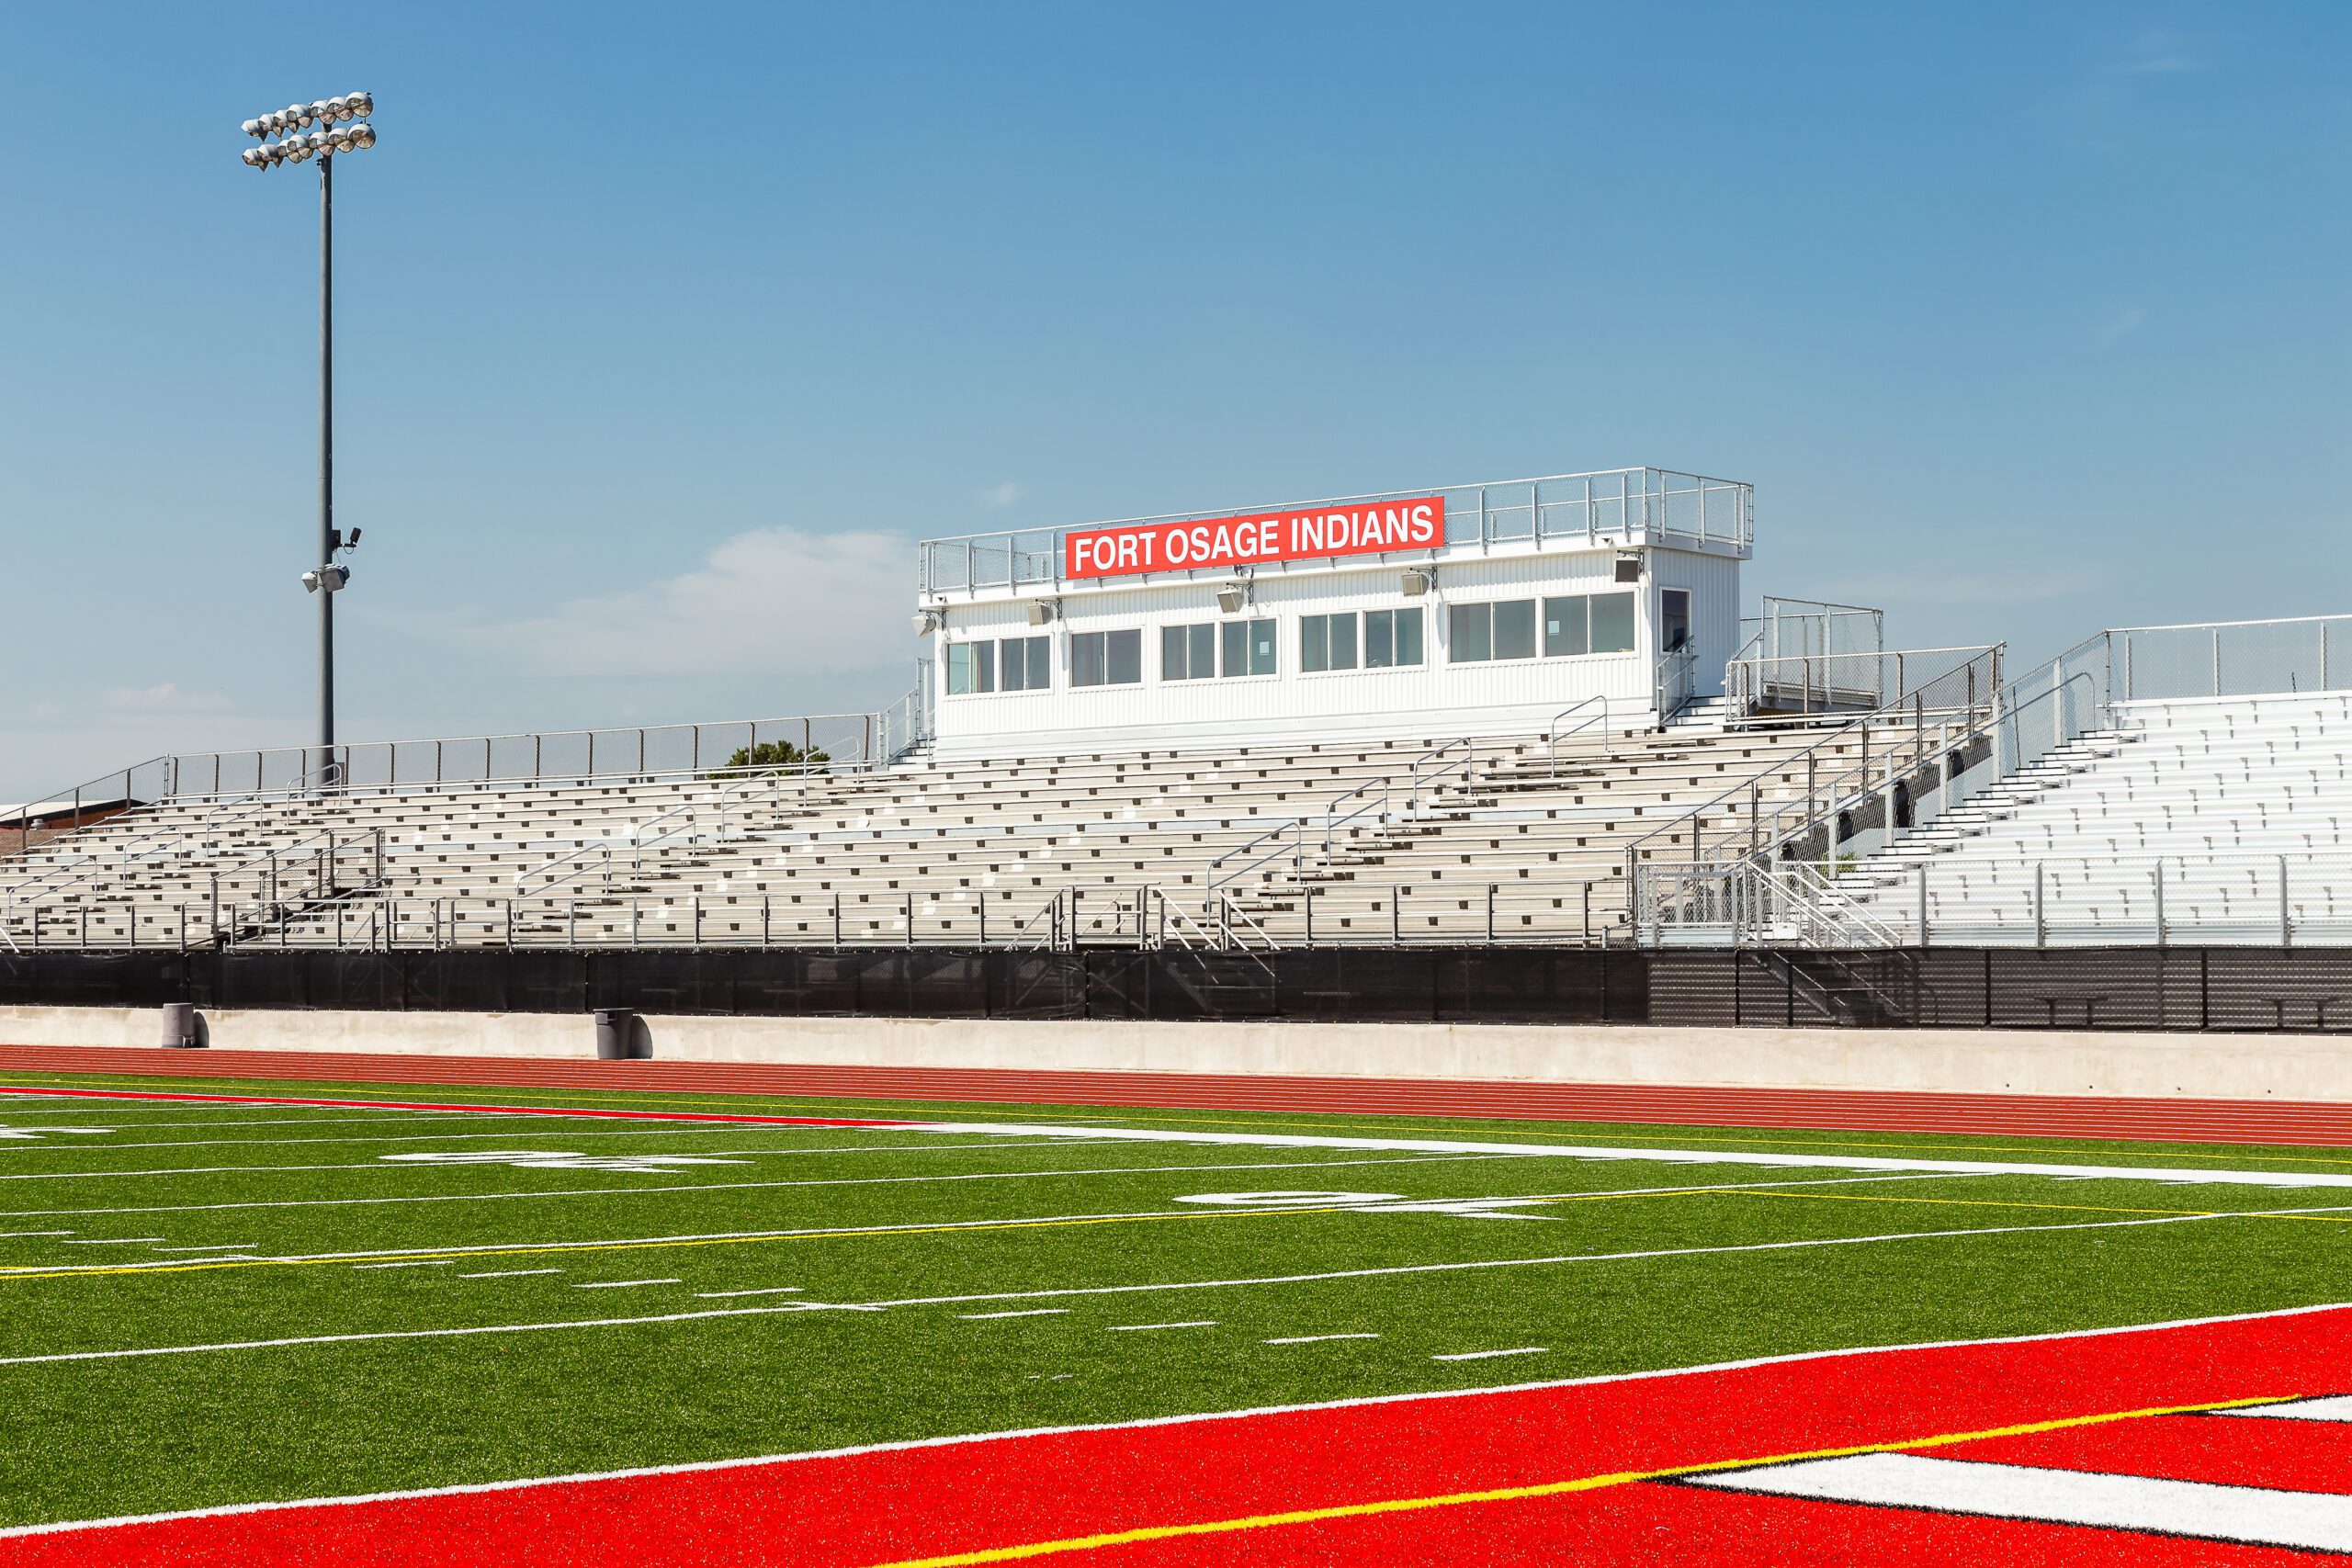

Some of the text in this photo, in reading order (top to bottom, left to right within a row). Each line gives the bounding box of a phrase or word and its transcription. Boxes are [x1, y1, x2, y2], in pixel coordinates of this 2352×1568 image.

[1074, 504, 1434, 571] FORT OSAGE INDIANS
